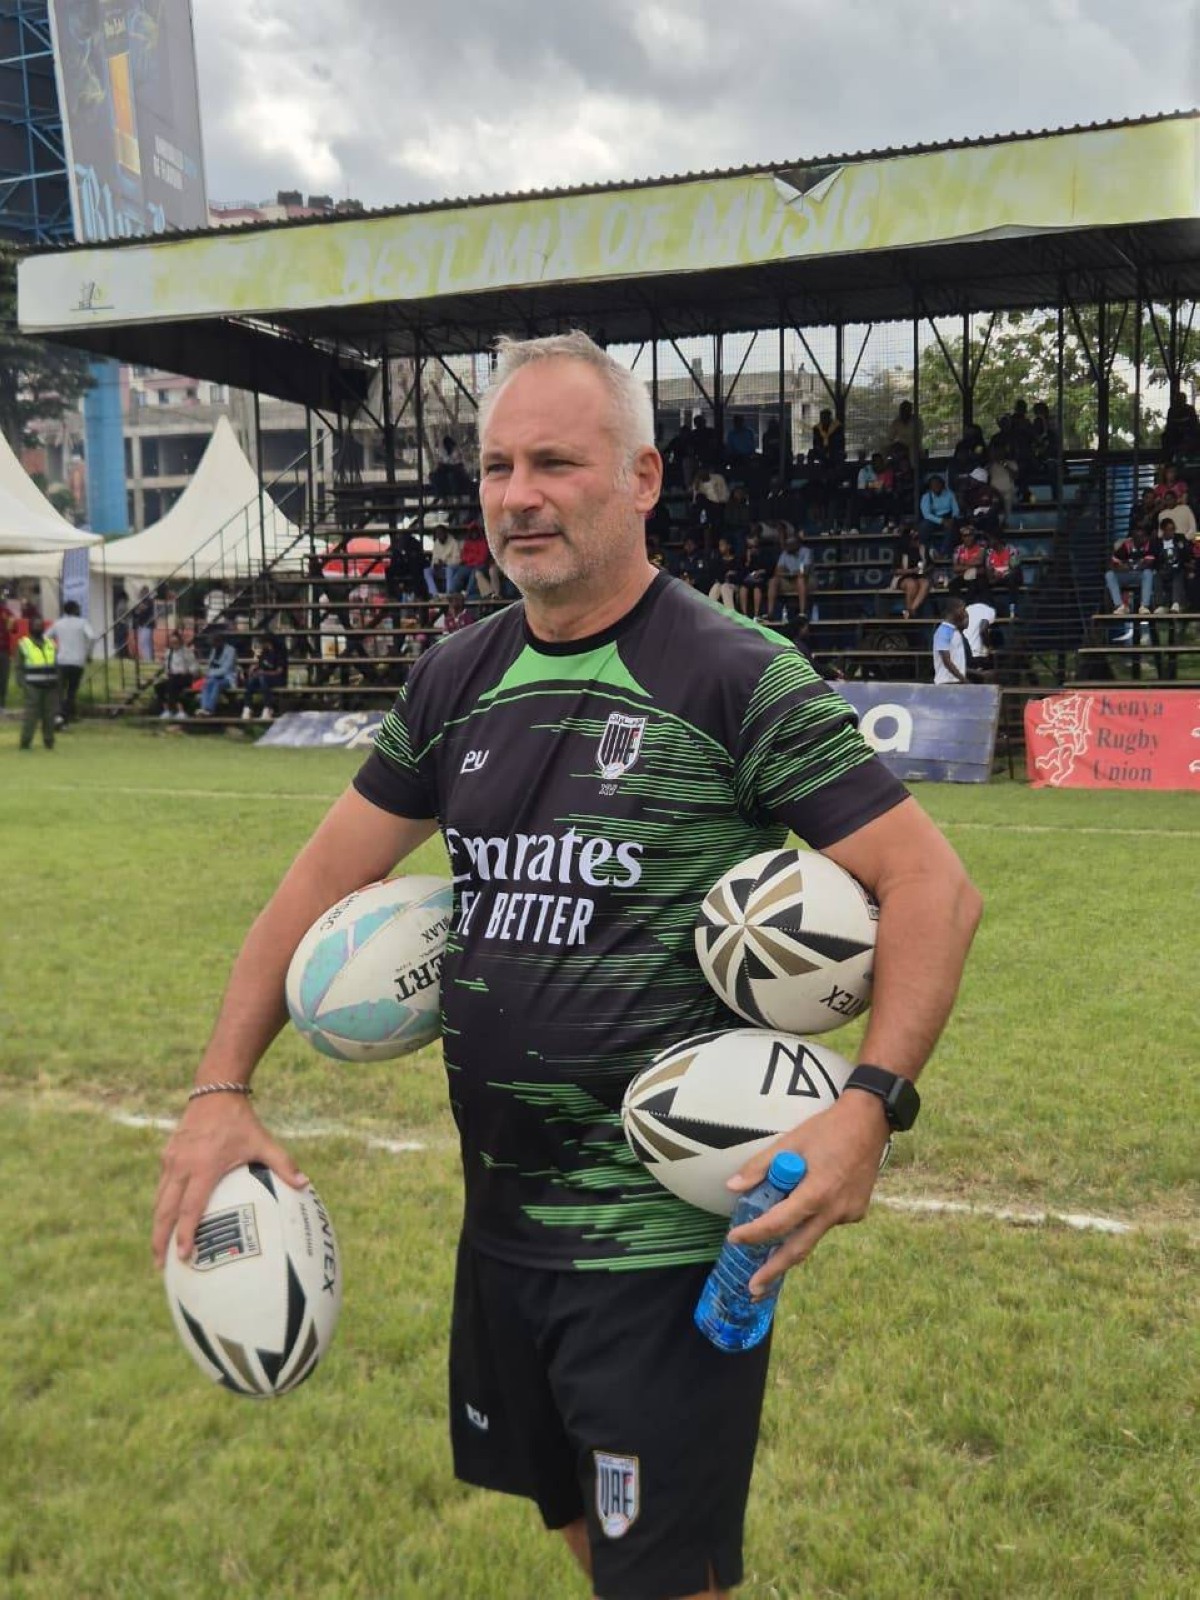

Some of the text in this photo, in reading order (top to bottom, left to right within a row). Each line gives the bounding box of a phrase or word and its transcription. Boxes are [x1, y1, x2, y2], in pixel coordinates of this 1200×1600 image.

[601, 200, 672, 268] OF
[1097, 727, 1160, 756] Rugby
[484, 892, 595, 945] BETTER
